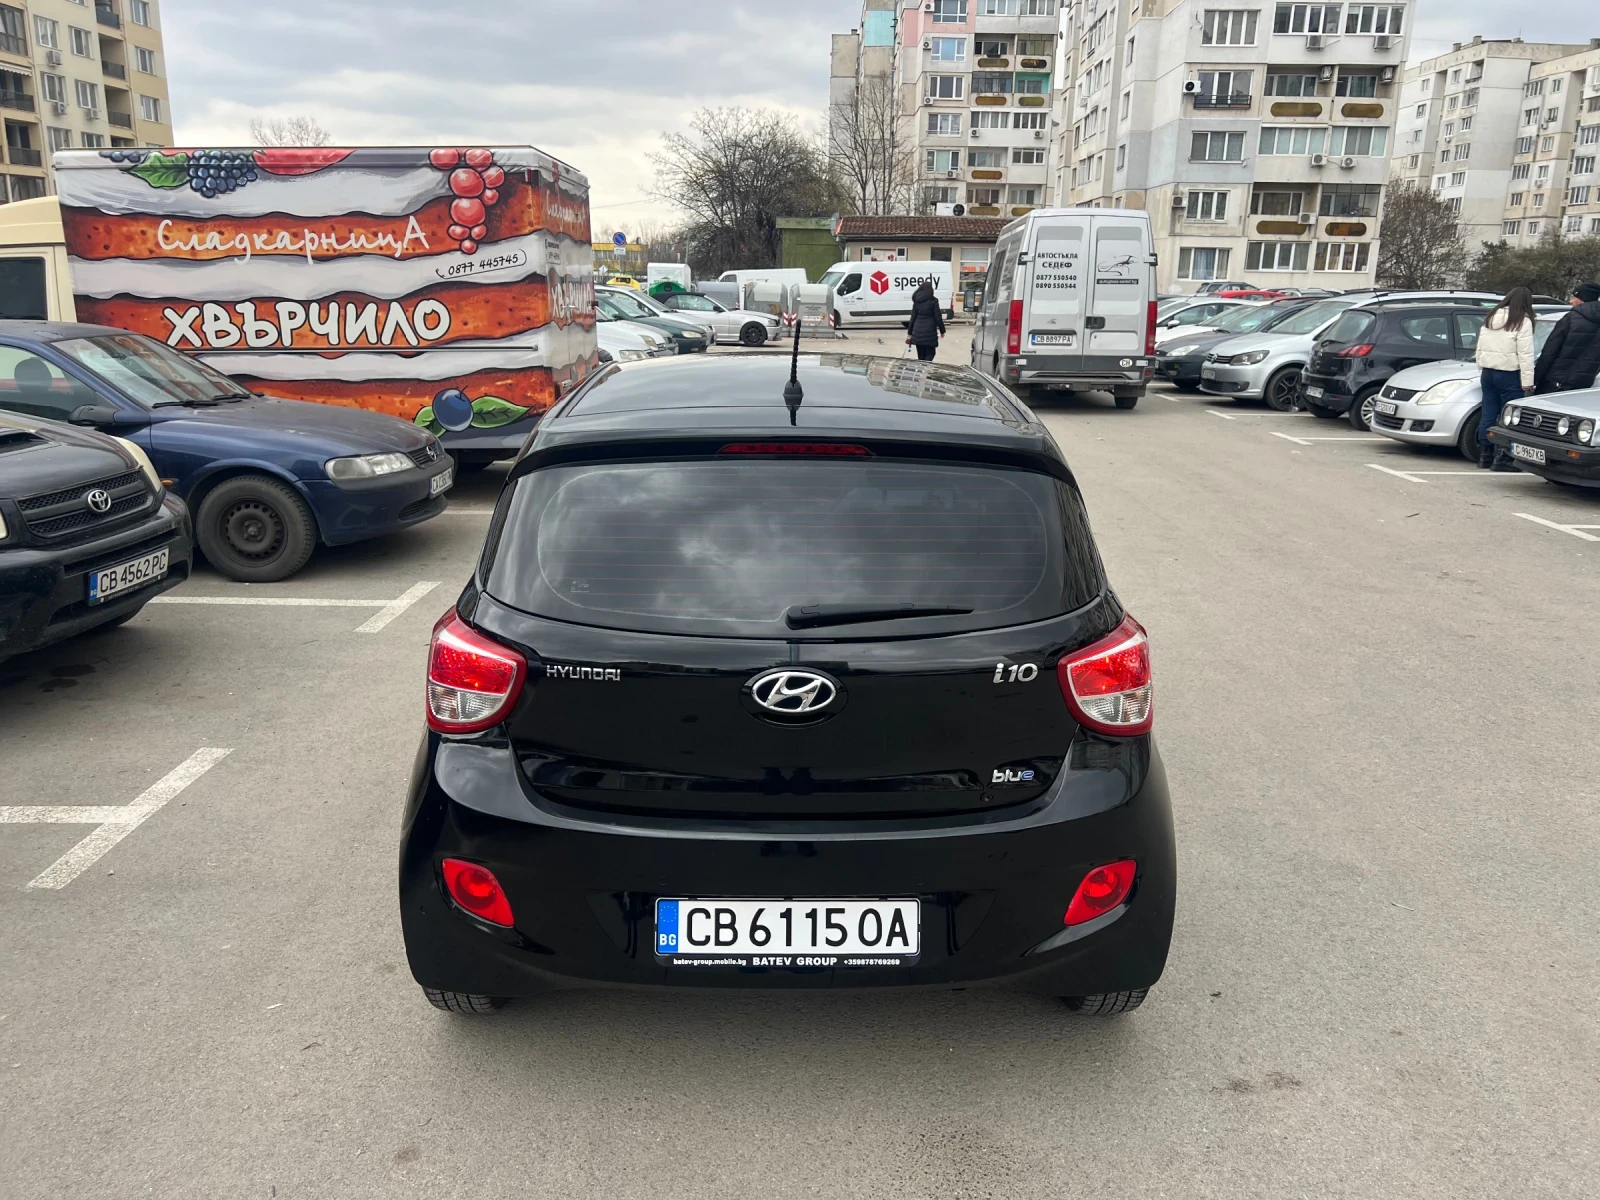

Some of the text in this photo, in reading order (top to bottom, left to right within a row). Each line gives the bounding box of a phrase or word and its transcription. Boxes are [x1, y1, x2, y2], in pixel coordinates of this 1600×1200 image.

[448, 253, 518, 275] 0877 445745
[1042, 261, 1073, 269] СЕДЕФ
[894, 272, 940, 291] speedy
[163, 299, 451, 348] ХВЪРЧИЛО
[1121, 359, 1131, 367] CH
[120, 558, 150, 585] 4562
[546, 664, 621, 682] HYUNDAI
[992, 662, 1039, 684] i10
[991, 768, 1035, 783] blue
[686, 907, 738, 947] CB
[749, 907, 848, 947] 6115
[659, 933, 677, 946] BG
[673, 958, 747, 966] batev-group.mobile.bg
[752, 956, 792, 966] BATEV
[796, 956, 838, 966] GROUP
